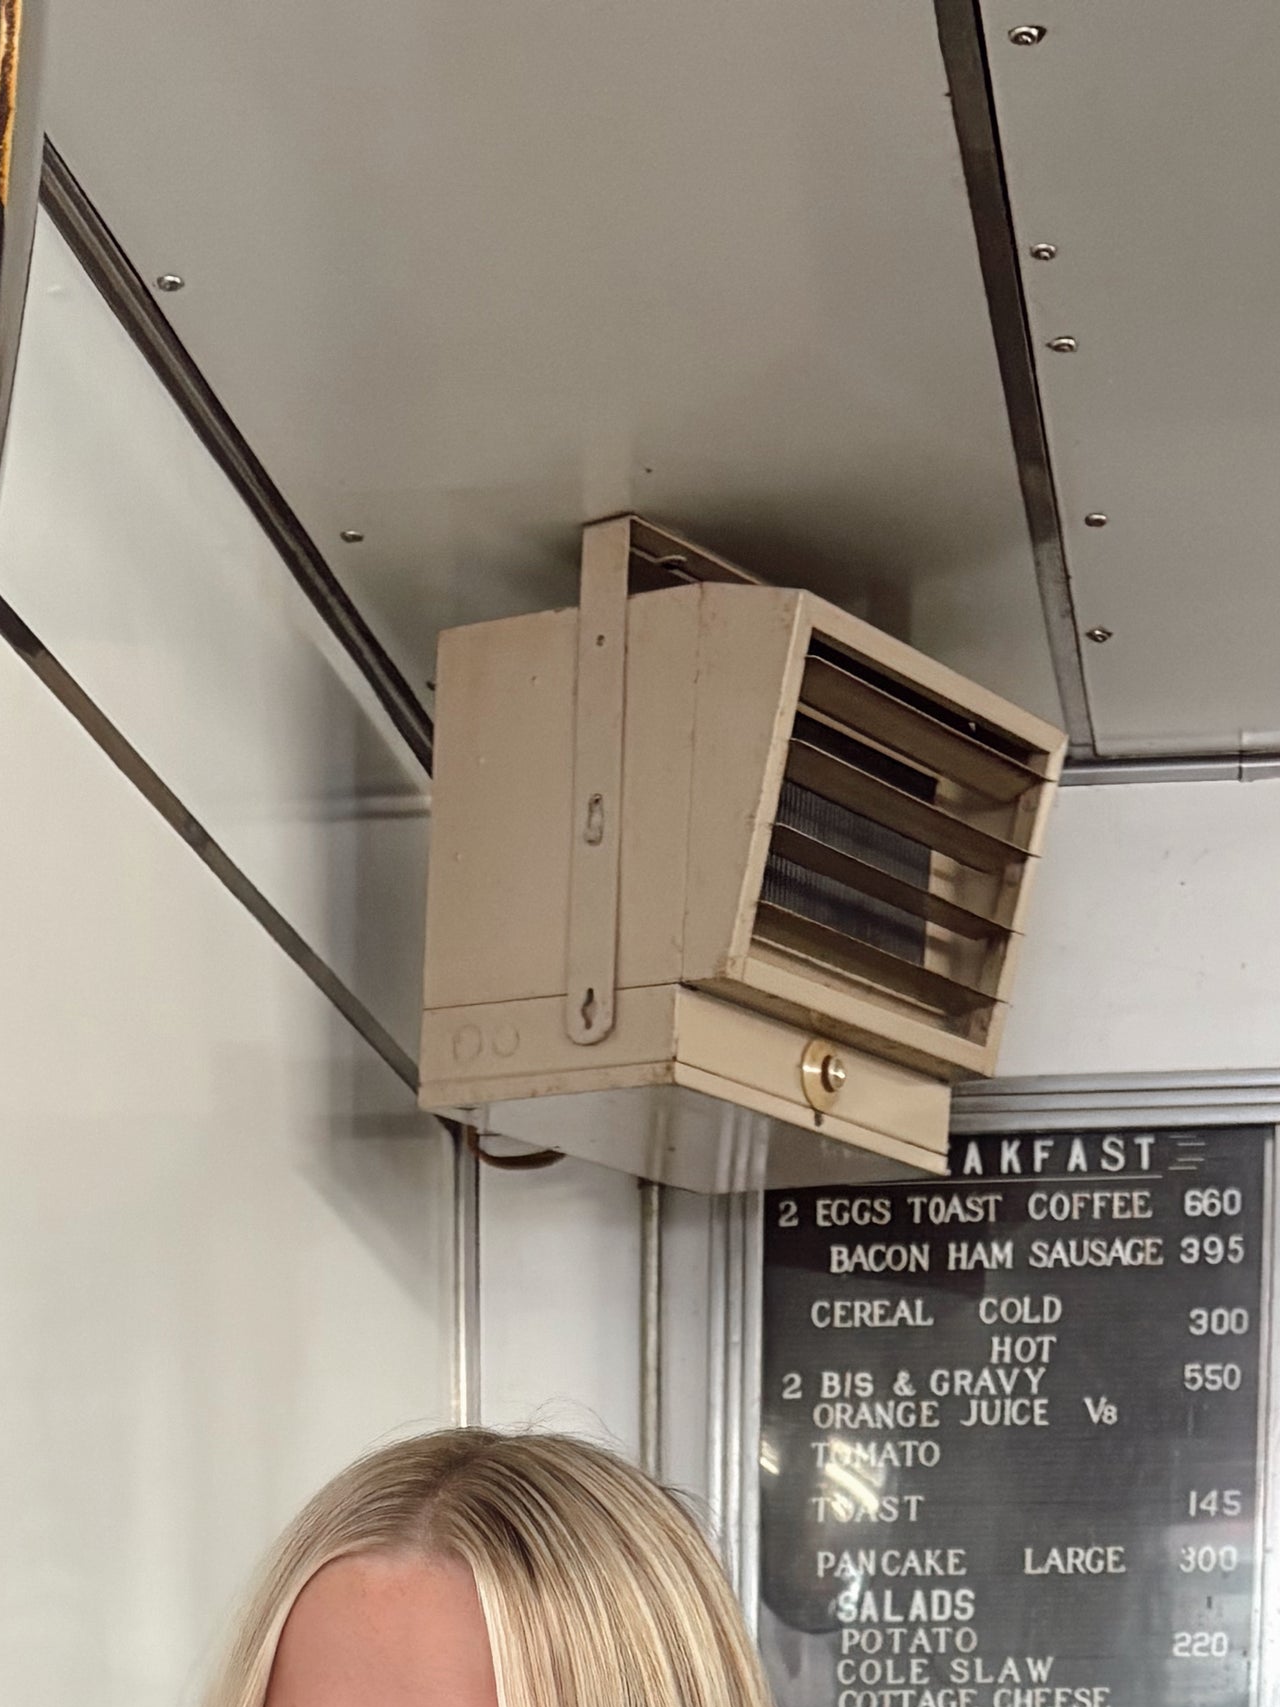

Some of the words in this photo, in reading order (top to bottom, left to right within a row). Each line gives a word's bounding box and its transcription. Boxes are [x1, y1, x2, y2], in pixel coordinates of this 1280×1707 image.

[948, 1136, 1155, 1176] AKFAST
[778, 1201, 799, 1226] 2
[816, 1196, 891, 1226] EGGS
[906, 1194, 1002, 1225] TOAST
[1028, 1189, 1152, 1221] COFFEE
[1184, 1189, 1242, 1216] 660
[829, 1244, 931, 1274] BACON
[948, 1241, 1014, 1270] HAM
[1029, 1238, 1164, 1269] SAUSAGE
[1180, 1238, 1245, 1265] 395
[810, 1299, 934, 1329] CEREAL
[979, 1294, 1062, 1325] COLD
[1188, 1308, 1249, 1335] 300
[991, 1336, 1056, 1365] HOT
[782, 1374, 802, 1400] 2
[821, 1370, 874, 1399] BIS
[892, 1370, 914, 1396] &
[930, 1366, 1046, 1398] GRAVY
[1184, 1364, 1242, 1391] 550
[812, 1400, 940, 1429] ORANGE
[959, 1399, 1049, 1428] JUICE
[811, 1441, 940, 1470] TOMATO
[811, 1495, 924, 1524] TOAST
[1188, 1490, 1242, 1516] 145
[818, 1548, 966, 1578] PANCAKE
[1024, 1546, 1126, 1575] LARGE
[1180, 1548, 1239, 1574] 300
[836, 1589, 975, 1622] SALADS
[841, 1628, 978, 1655] POTATO
[1172, 1631, 1229, 1659] 220
[836, 1659, 930, 1686] COLE
[950, 1656, 1055, 1685] SLAW
